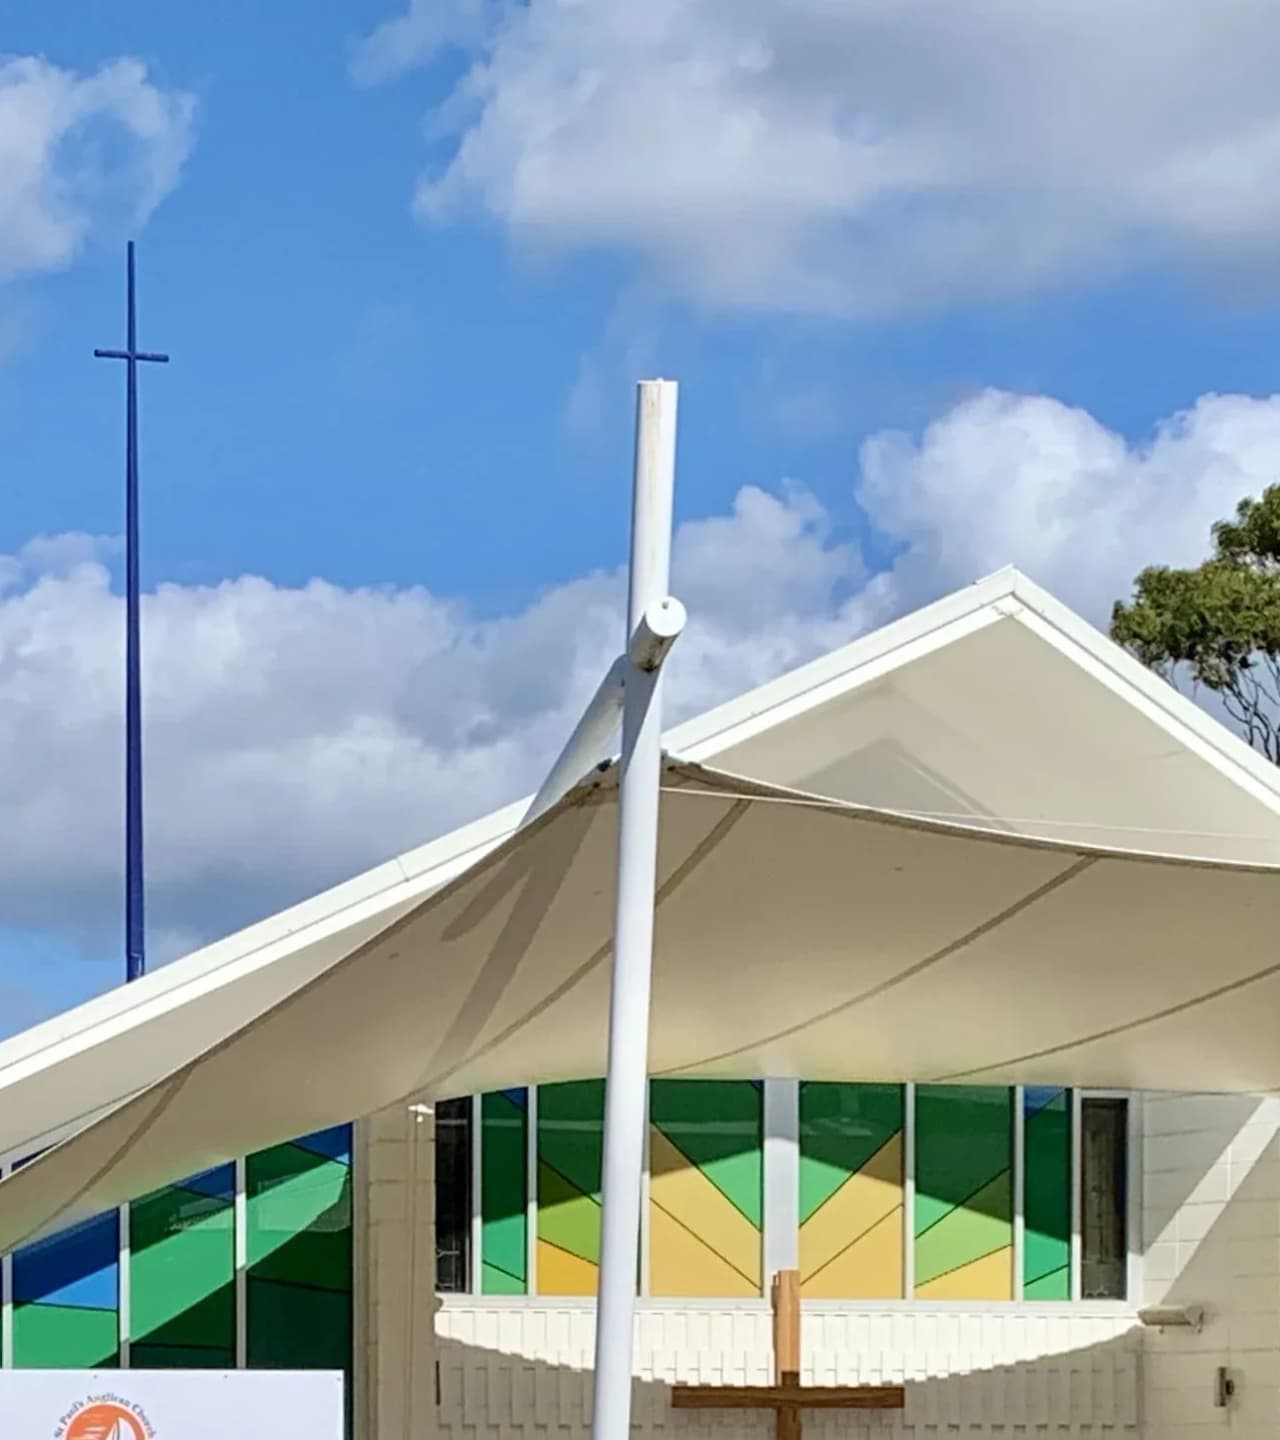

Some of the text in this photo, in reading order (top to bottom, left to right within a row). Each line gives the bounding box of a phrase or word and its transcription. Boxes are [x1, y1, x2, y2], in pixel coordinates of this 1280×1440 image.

[53, 1426, 65, 1439] St
[59, 1400, 85, 1426] Paul's
[131, 1403, 157, 1438] Church
